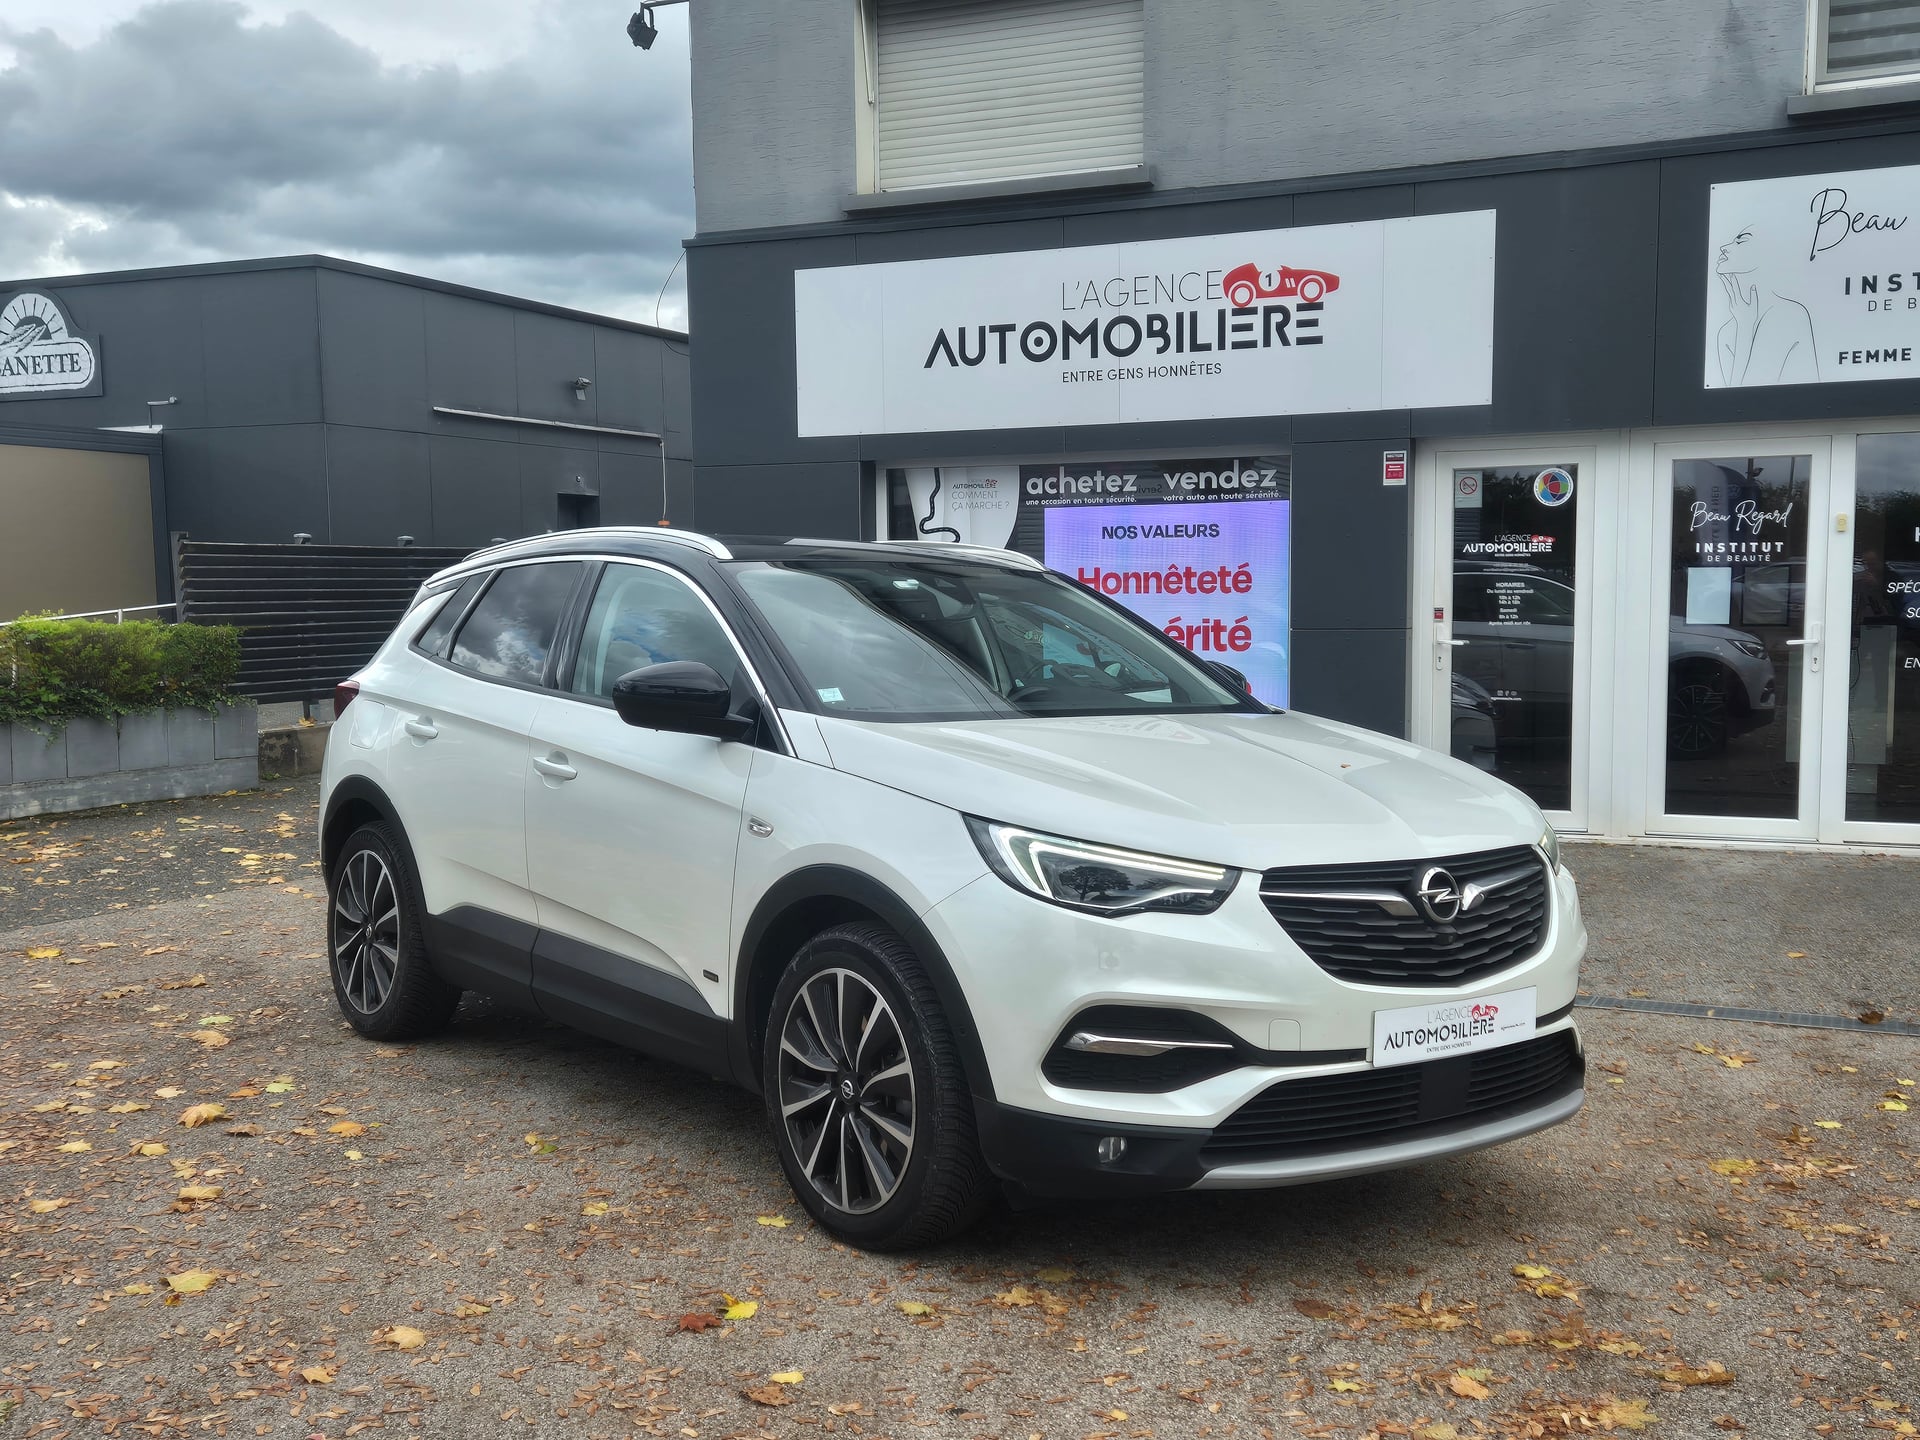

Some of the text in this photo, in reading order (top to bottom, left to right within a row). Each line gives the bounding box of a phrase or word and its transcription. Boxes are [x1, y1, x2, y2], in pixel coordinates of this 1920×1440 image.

[1810, 187, 1907, 262] Beau
[1062, 269, 1222, 311] L'AGENCE
[1868, 298, 1893, 312] DE
[0, 353, 82, 377] ANETTE
[1838, 347, 1912, 365] FEMME
[1062, 360, 1222, 383] ENTRE GENS HONNÊTES
[1026, 465, 1138, 495] achetez
[1163, 459, 1277, 490] vendez
[951, 490, 999, 500] COMMENT
[1041, 496, 1071, 505] occasion
[1186, 493, 1205, 501] auto
[1220, 492, 1243, 500] toute
[965, 501, 1004, 510] MARCHE
[1690, 501, 1731, 532] Beau
[1735, 499, 1793, 535] Regard
[1101, 523, 1220, 540] NOS VALEURS
[1494, 534, 1532, 542] L'AGENCE
[1695, 541, 1784, 554] INSTITUT
[1727, 552, 1771, 562] BEAUTÉ
[1077, 562, 1253, 595] Honnêteté
[1162, 615, 1252, 652] érité
[1427, 1005, 1472, 1024] L'AGENCE
